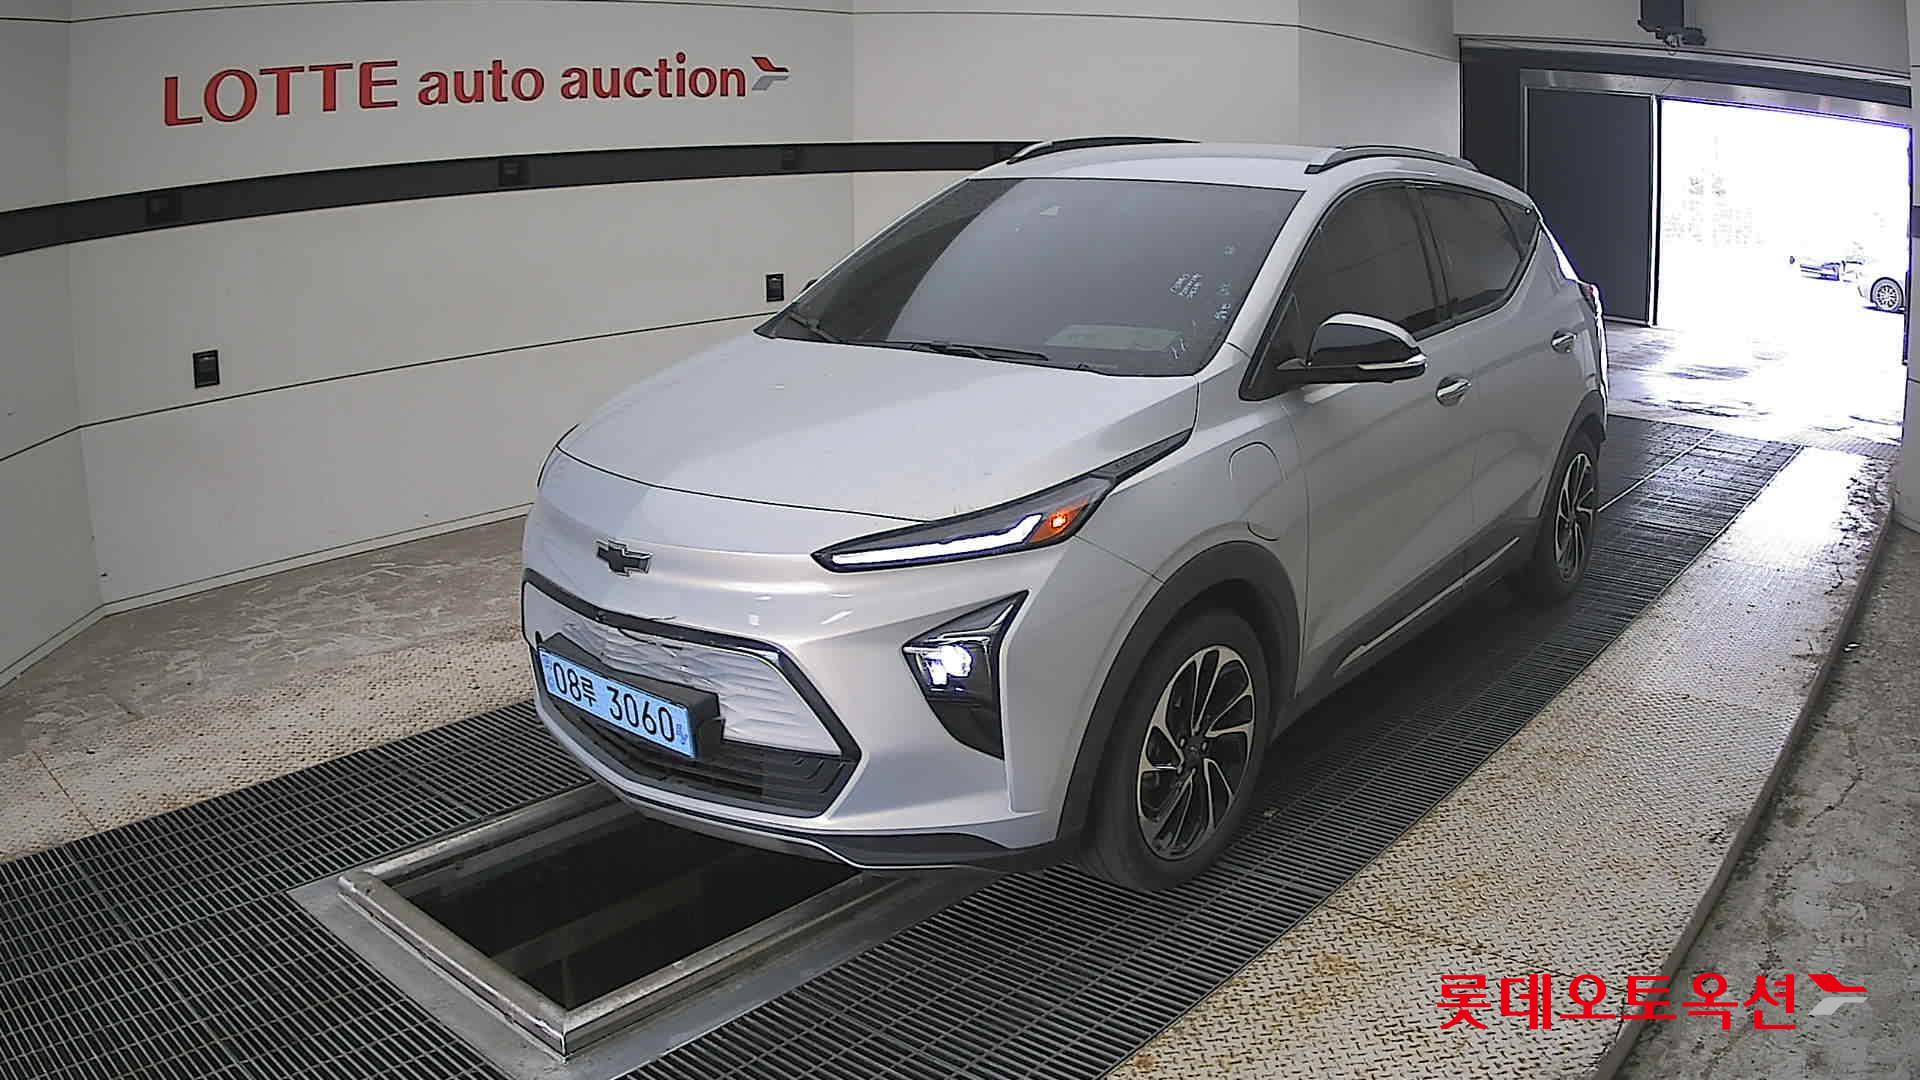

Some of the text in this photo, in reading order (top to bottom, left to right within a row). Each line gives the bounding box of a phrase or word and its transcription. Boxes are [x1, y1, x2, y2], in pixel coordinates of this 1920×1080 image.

[163, 51, 748, 127] LOTTE auto auction
[552, 662, 675, 742] 08루 3060
